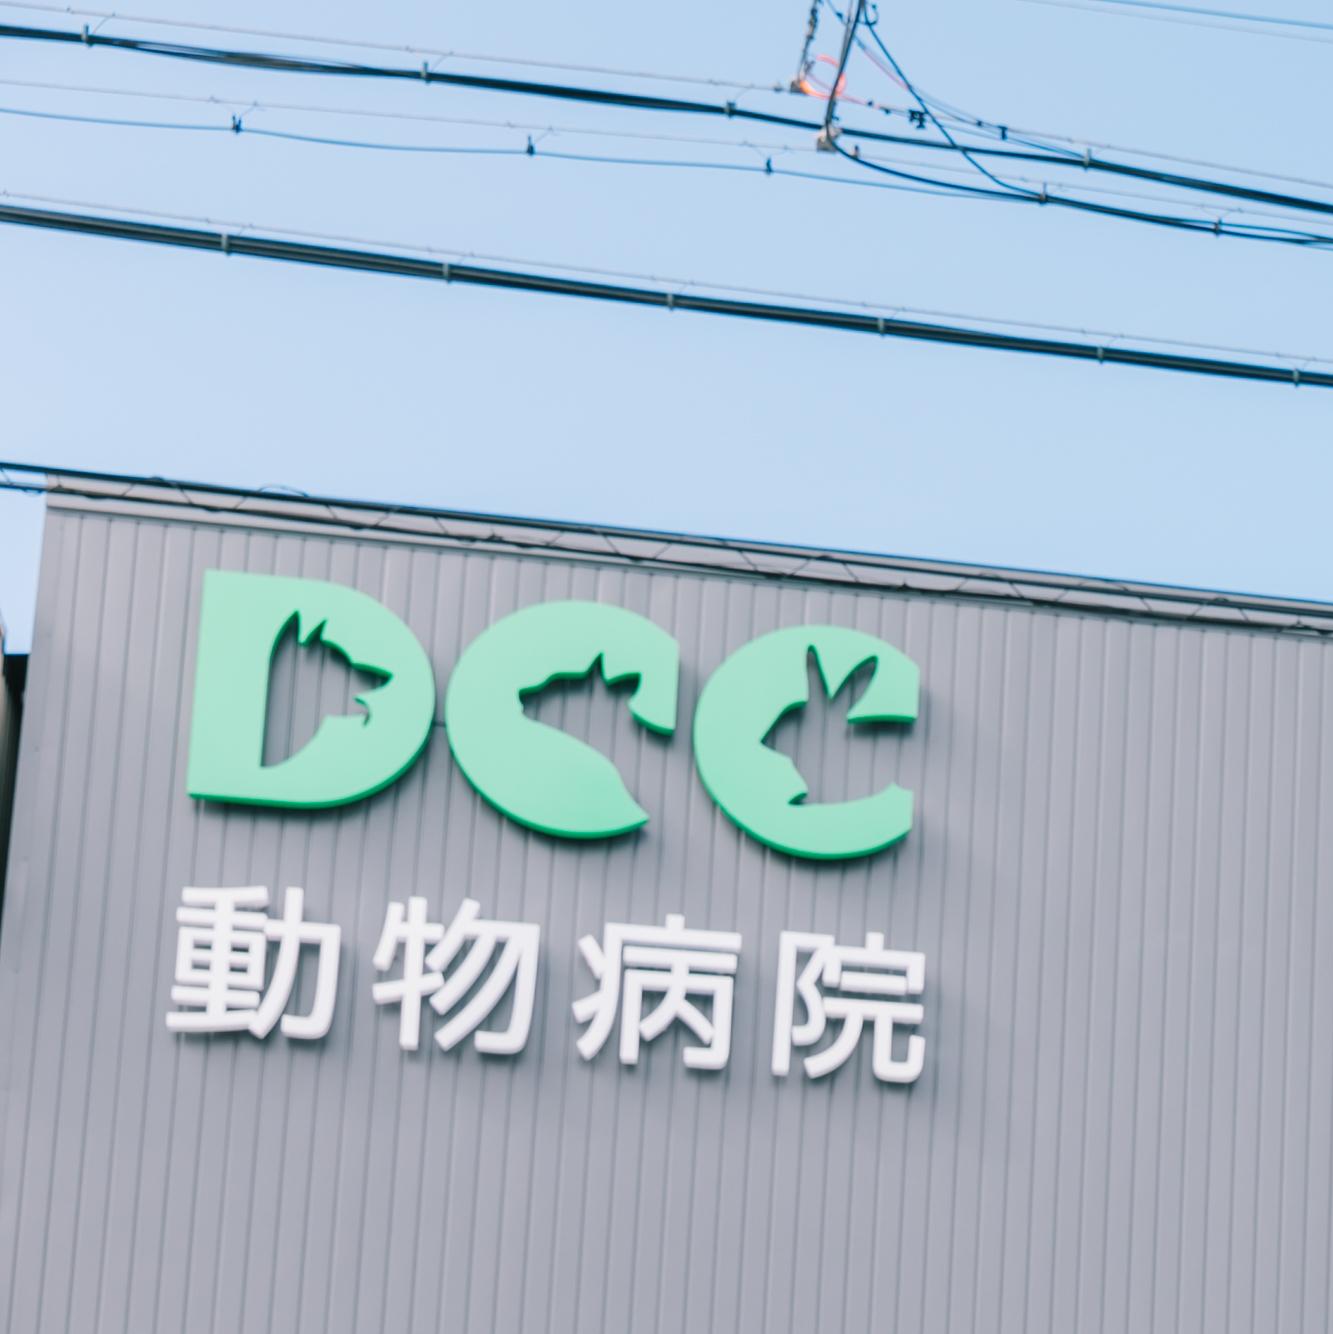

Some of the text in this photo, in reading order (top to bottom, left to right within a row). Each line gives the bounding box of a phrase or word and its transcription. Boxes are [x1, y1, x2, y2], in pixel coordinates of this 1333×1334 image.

[187, 569, 920, 859] DCC
[166, 885, 926, 1084] 動物病院
